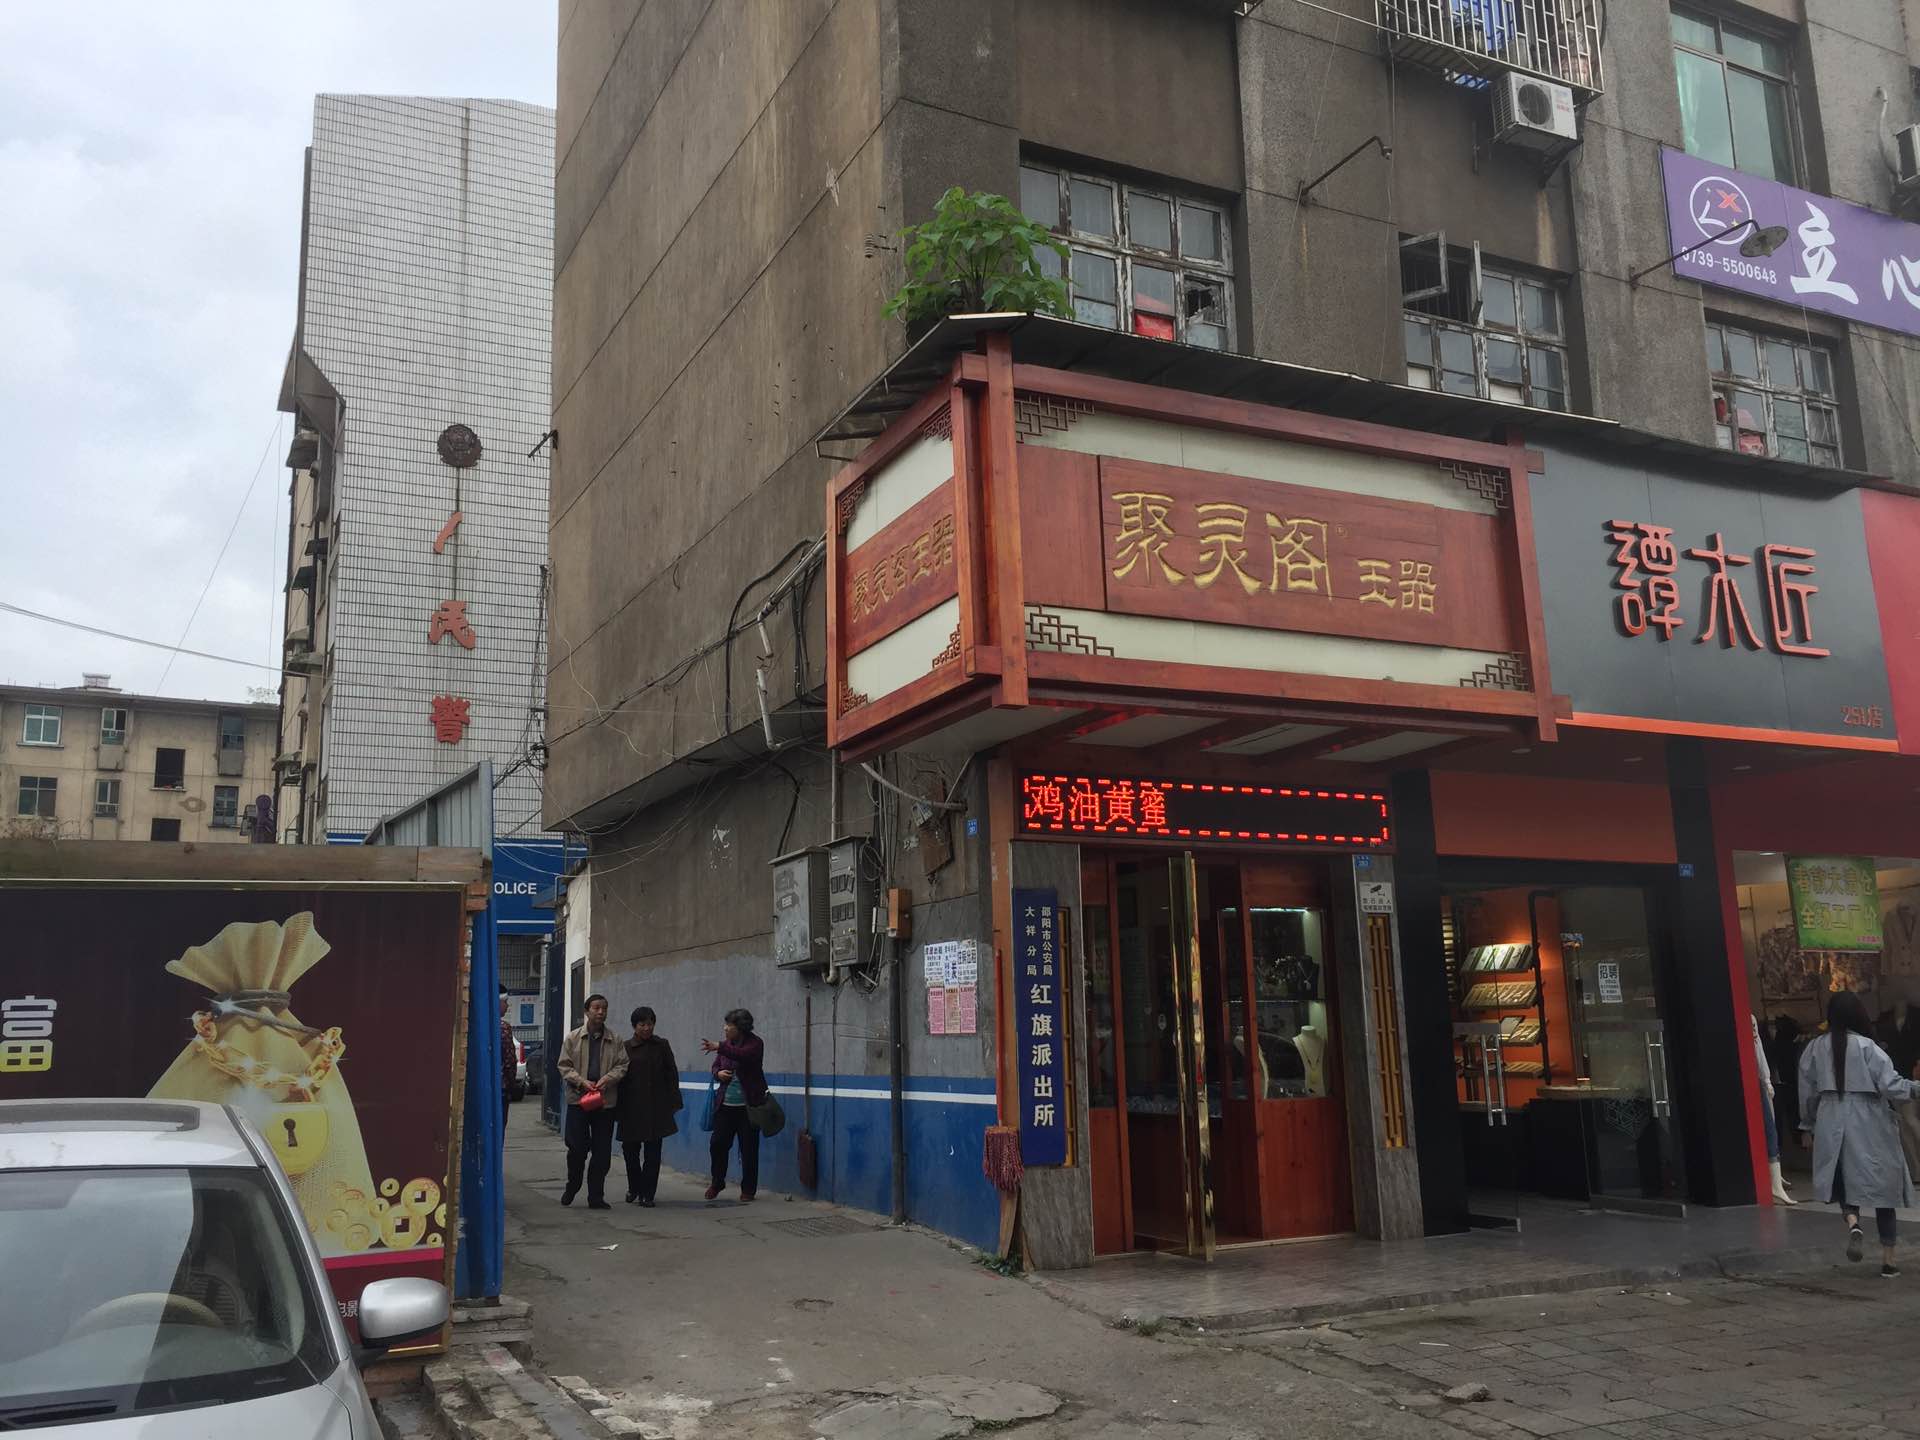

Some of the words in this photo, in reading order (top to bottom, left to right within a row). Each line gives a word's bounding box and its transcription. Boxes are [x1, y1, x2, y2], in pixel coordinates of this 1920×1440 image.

[1681, 246, 1778, 285] 0739-5500648
[1111, 490, 1332, 600] 聚灵阁
[1358, 559, 1437, 615] 玉器
[1029, 783, 1167, 828] 鸡油黄蜜
[494, 881, 537, 895] OLICE
[1025, 907, 1037, 977] 大祥分局
[1041, 906, 1053, 977] 邵阳市公安局
[0, 995, 58, 1073] 富
[1030, 983, 1055, 1127] 红旗派出所
